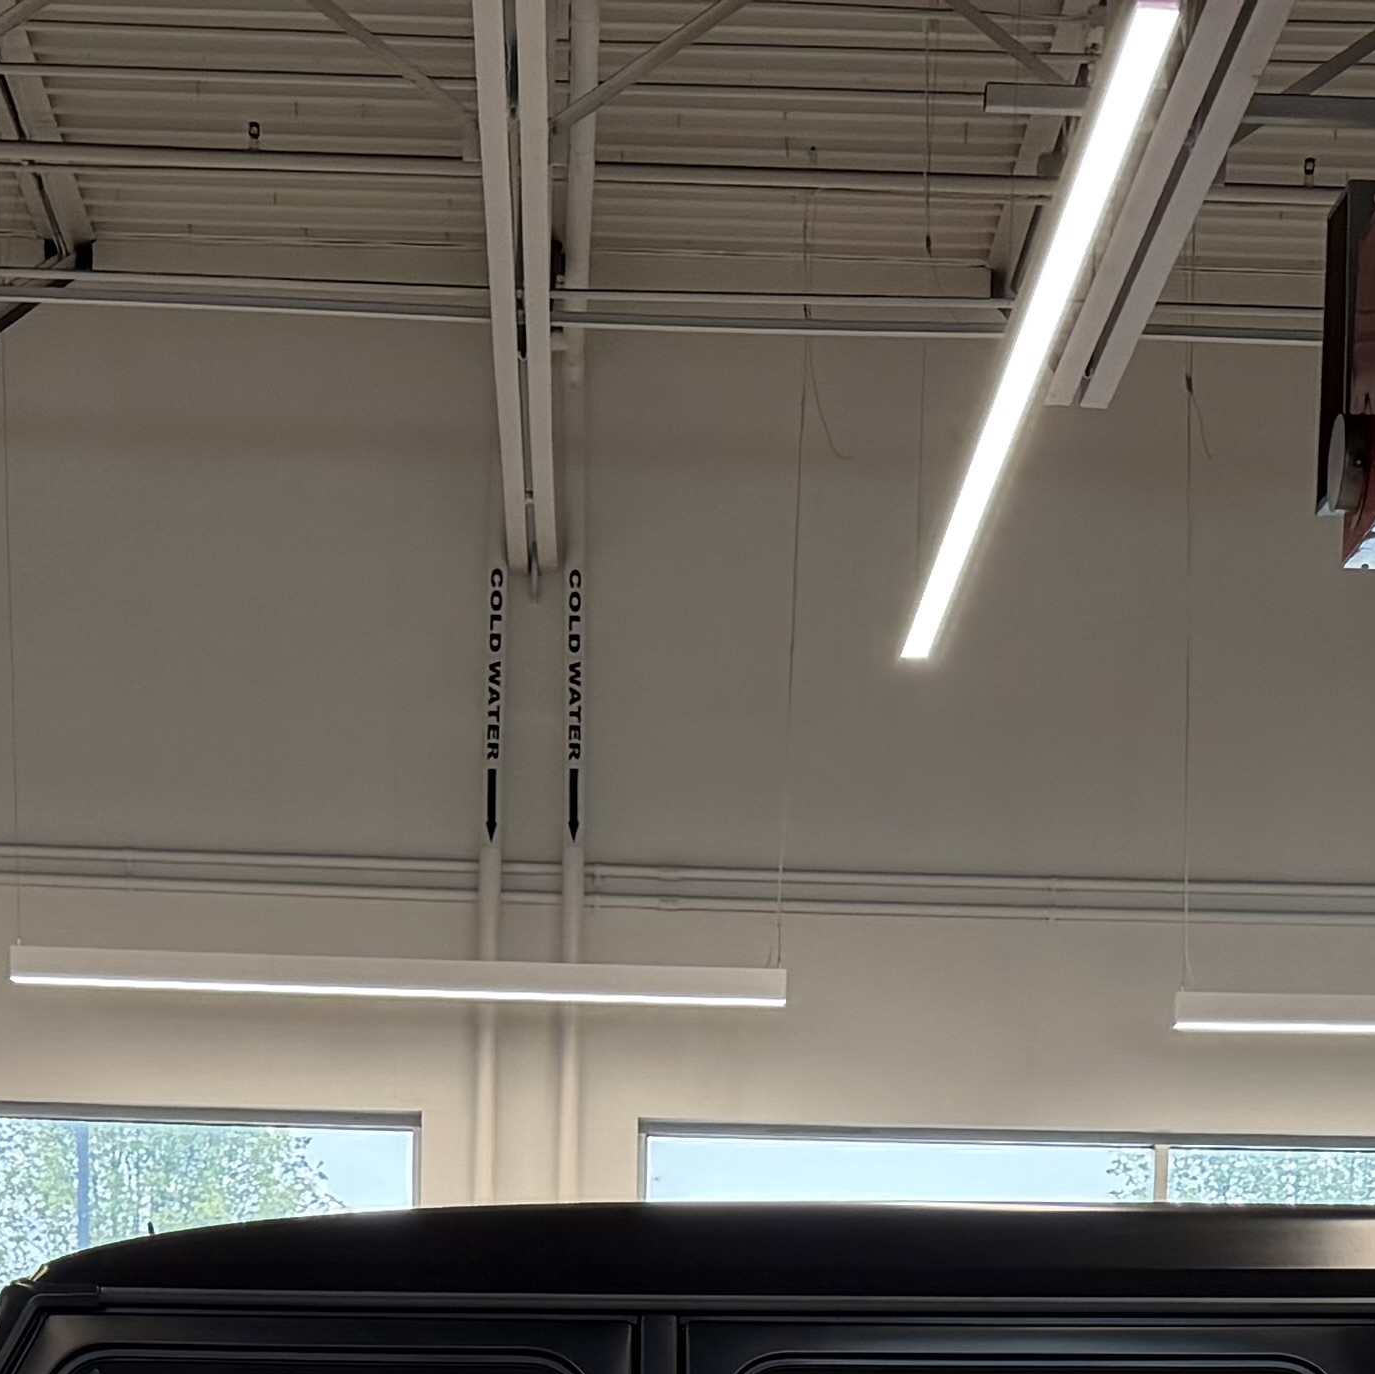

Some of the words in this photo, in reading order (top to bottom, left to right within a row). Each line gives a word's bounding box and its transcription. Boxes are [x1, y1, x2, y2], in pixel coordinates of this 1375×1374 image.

[489, 568, 504, 653] COLD
[568, 569, 582, 654] COLD
[487, 661, 501, 760] WATER
[568, 661, 582, 761] WATER
